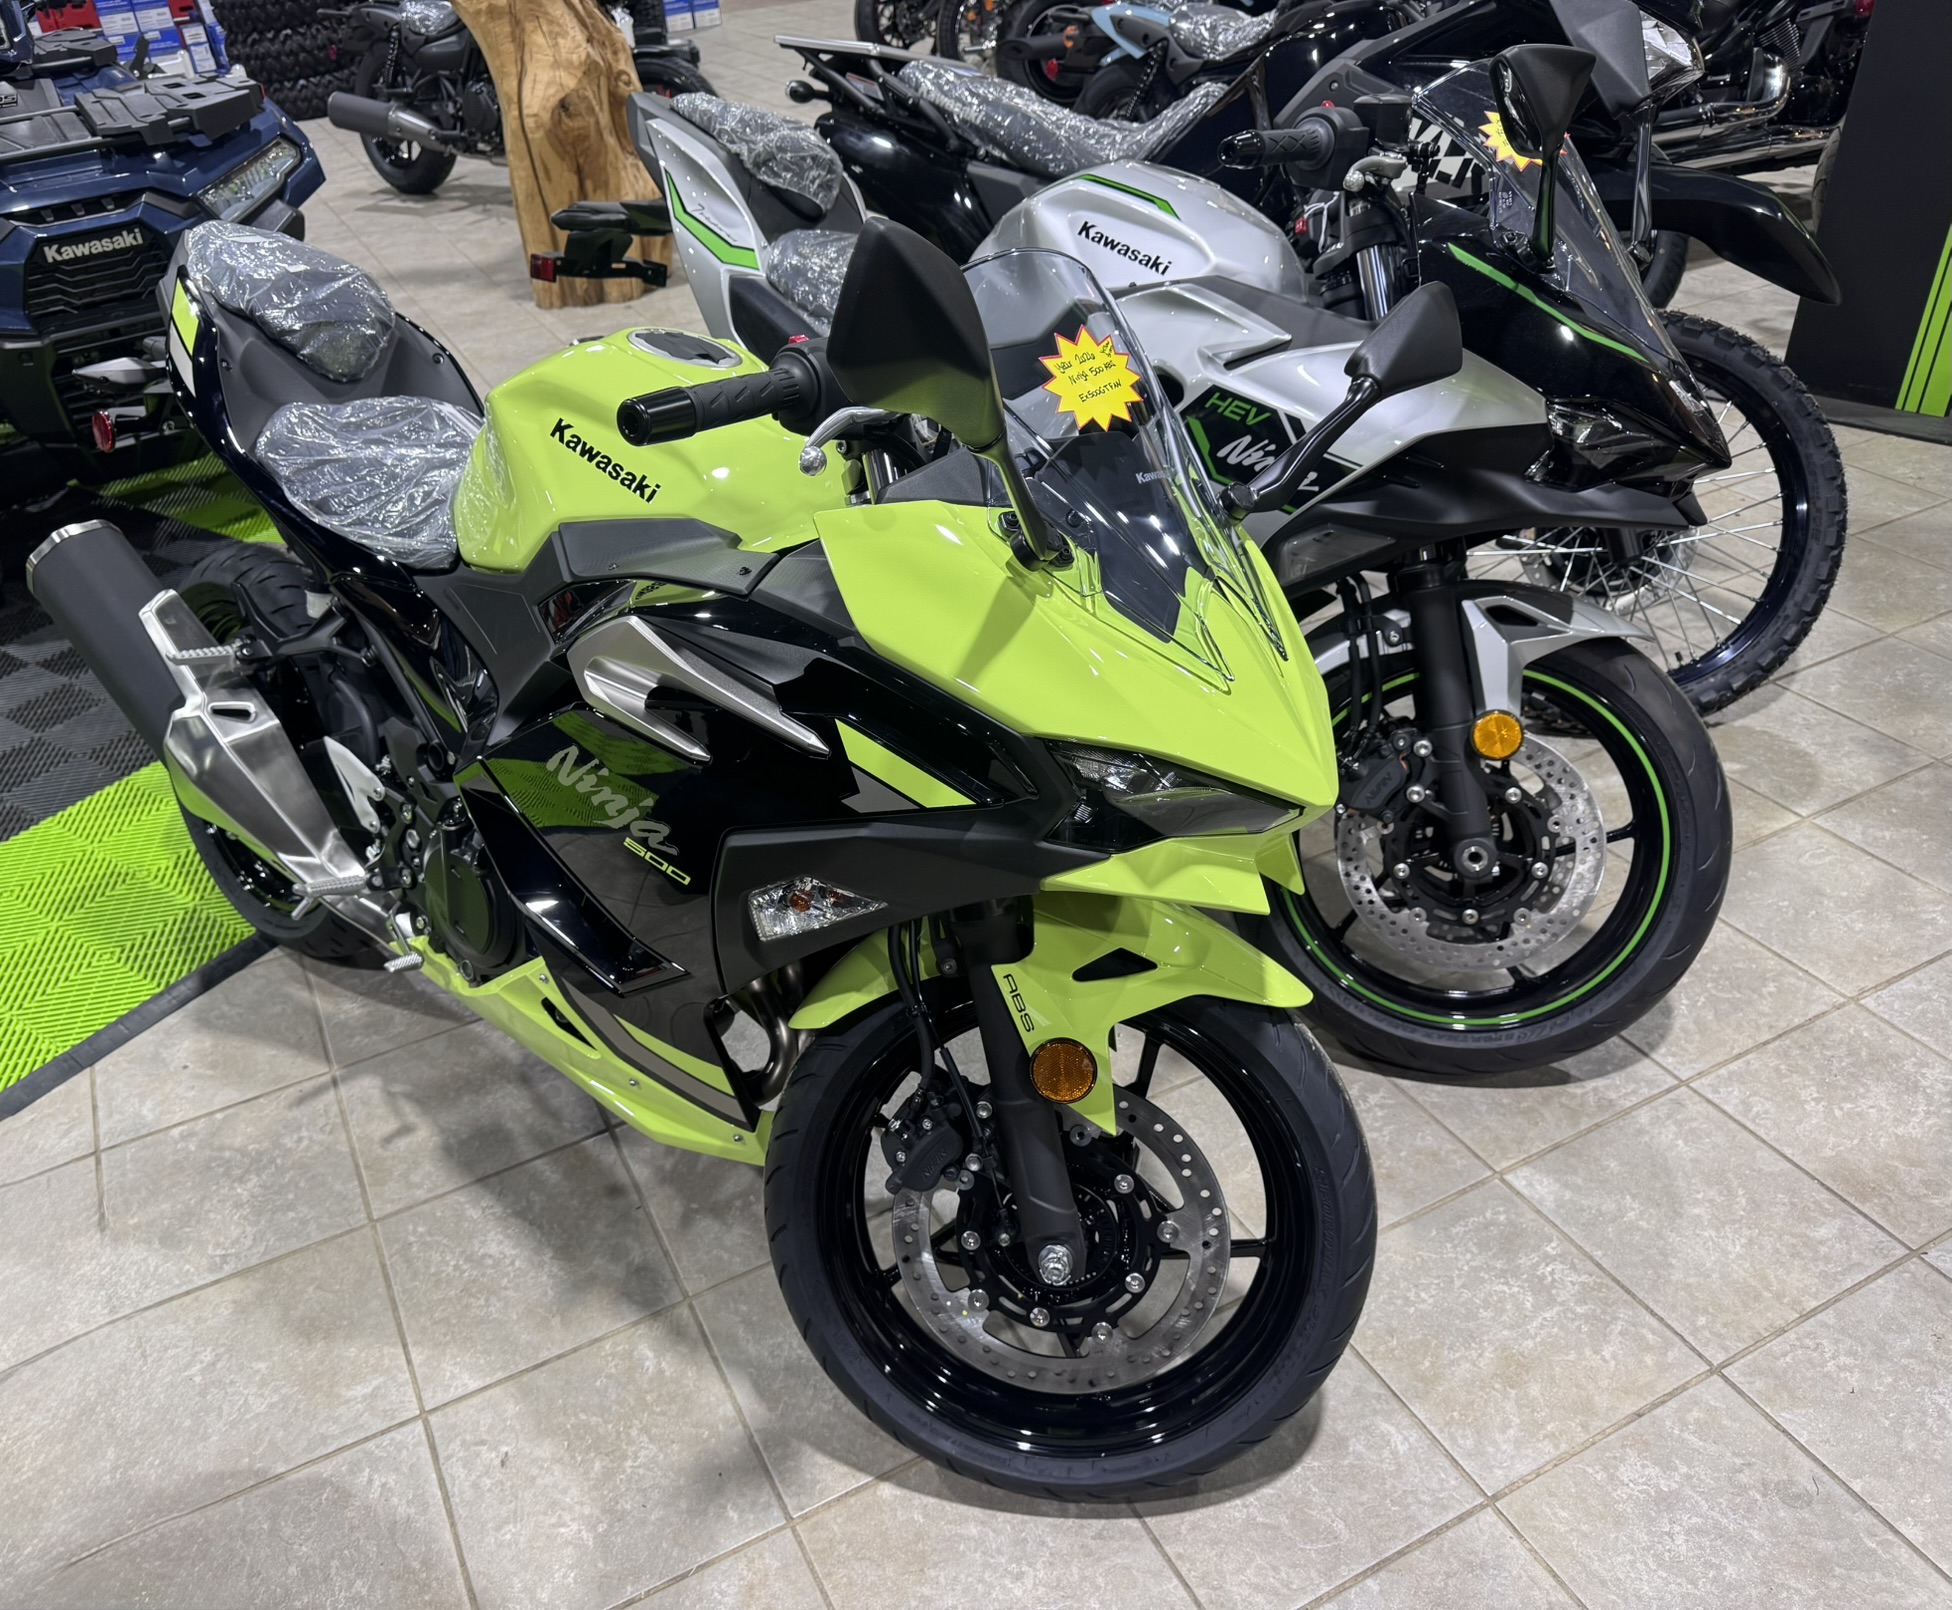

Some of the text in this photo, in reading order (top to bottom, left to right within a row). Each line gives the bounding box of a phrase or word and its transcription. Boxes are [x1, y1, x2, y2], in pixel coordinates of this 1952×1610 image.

[43, 228, 144, 263] Kawasaki
[1077, 220, 1173, 276] Kawasaki
[1089, 366, 1104, 376] 500
[1204, 392, 1271, 426] HEV
[550, 417, 662, 504] Kawasaki
[546, 743, 680, 856] Ninja
[623, 837, 691, 886] 500
[1003, 973, 1035, 1033] ABS
